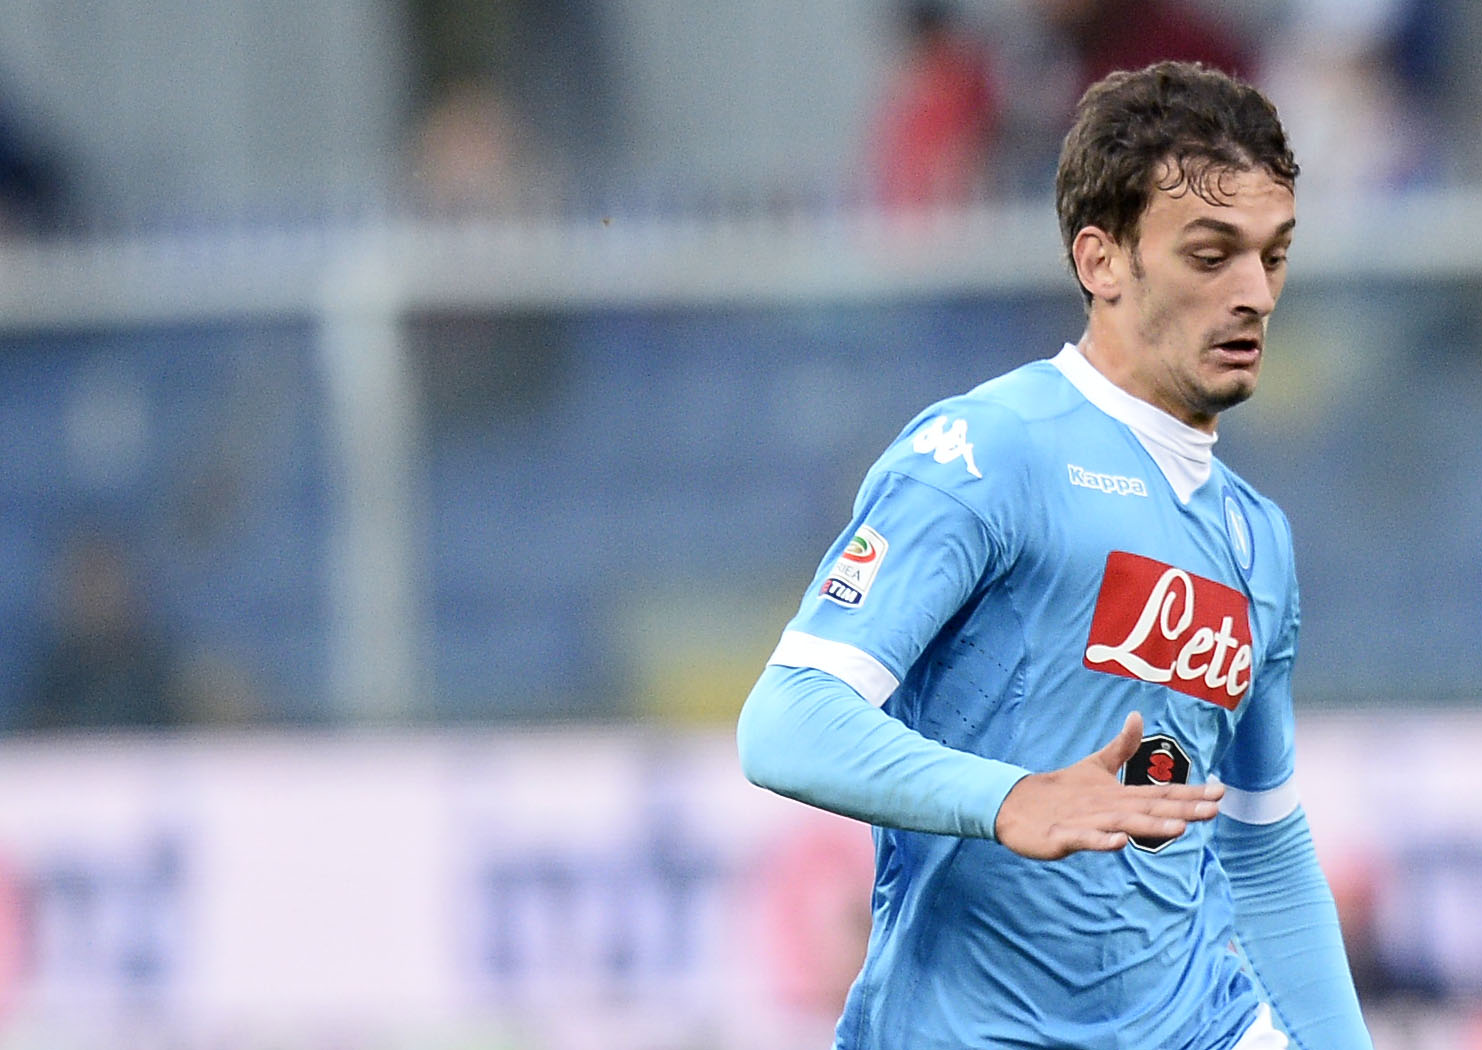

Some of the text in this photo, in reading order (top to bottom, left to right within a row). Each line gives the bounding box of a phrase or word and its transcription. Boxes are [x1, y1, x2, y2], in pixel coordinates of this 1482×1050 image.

[1067, 463, 1148, 497] Kappa
[828, 580, 859, 603] TIM
[1085, 567, 1252, 697] Lete
